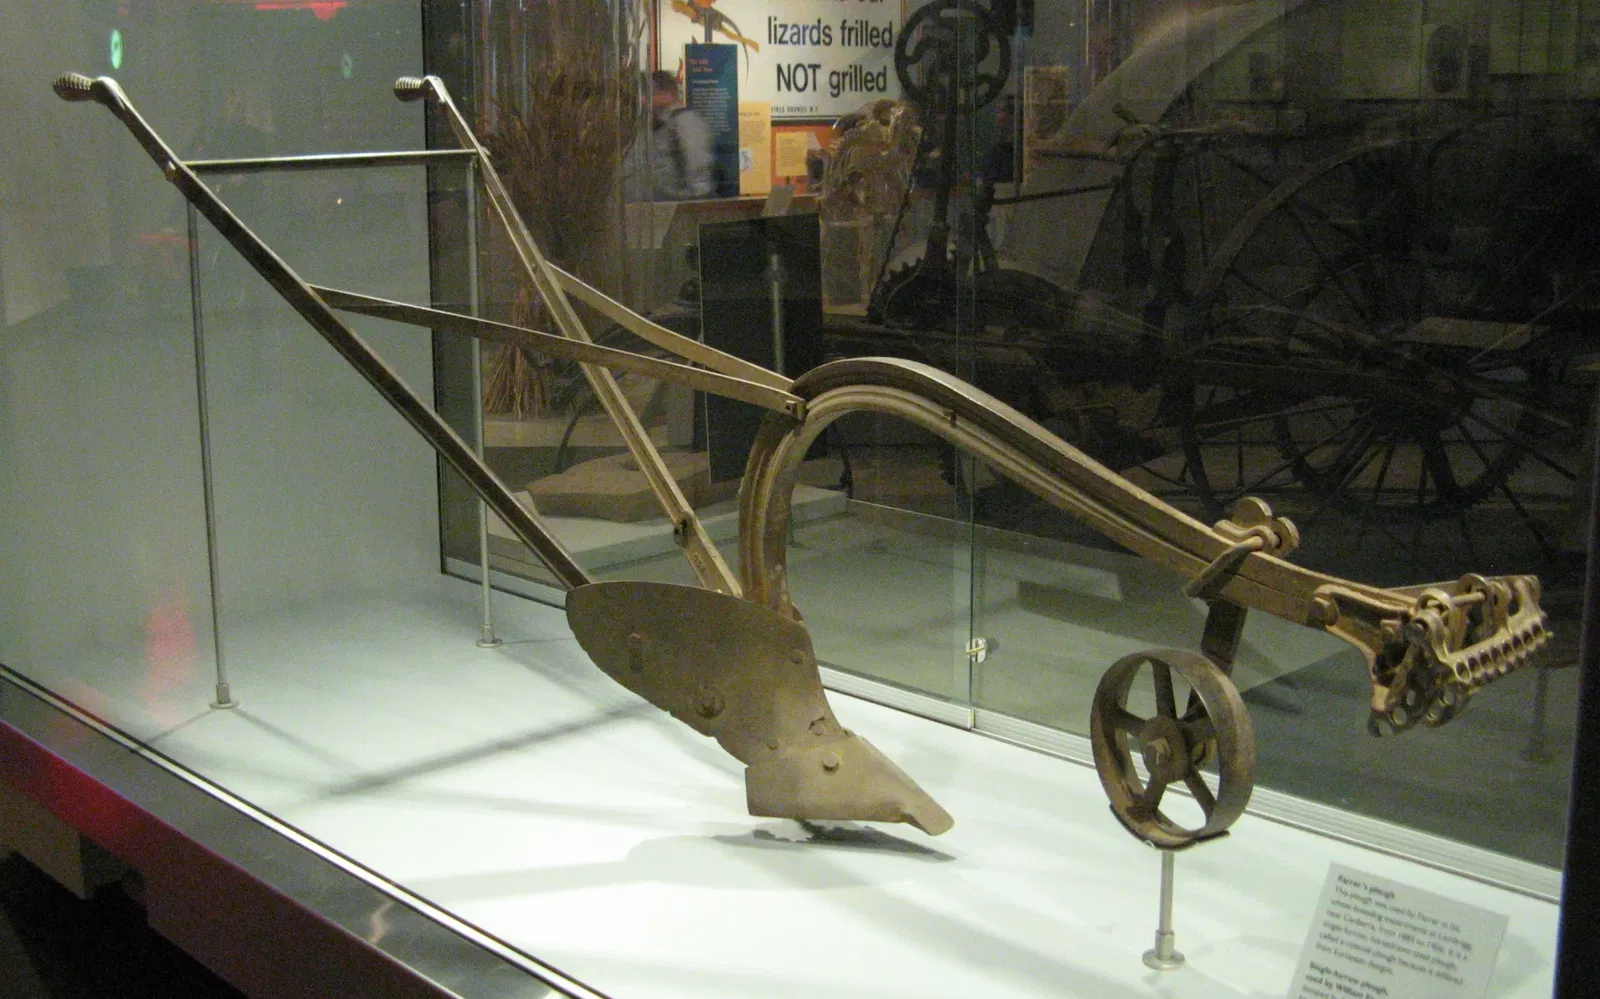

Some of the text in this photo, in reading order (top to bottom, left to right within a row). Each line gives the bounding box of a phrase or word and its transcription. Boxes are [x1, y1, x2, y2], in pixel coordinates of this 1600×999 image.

[768, 16, 893, 48] lizards frilled
[777, 63, 887, 98] NOT grilled
